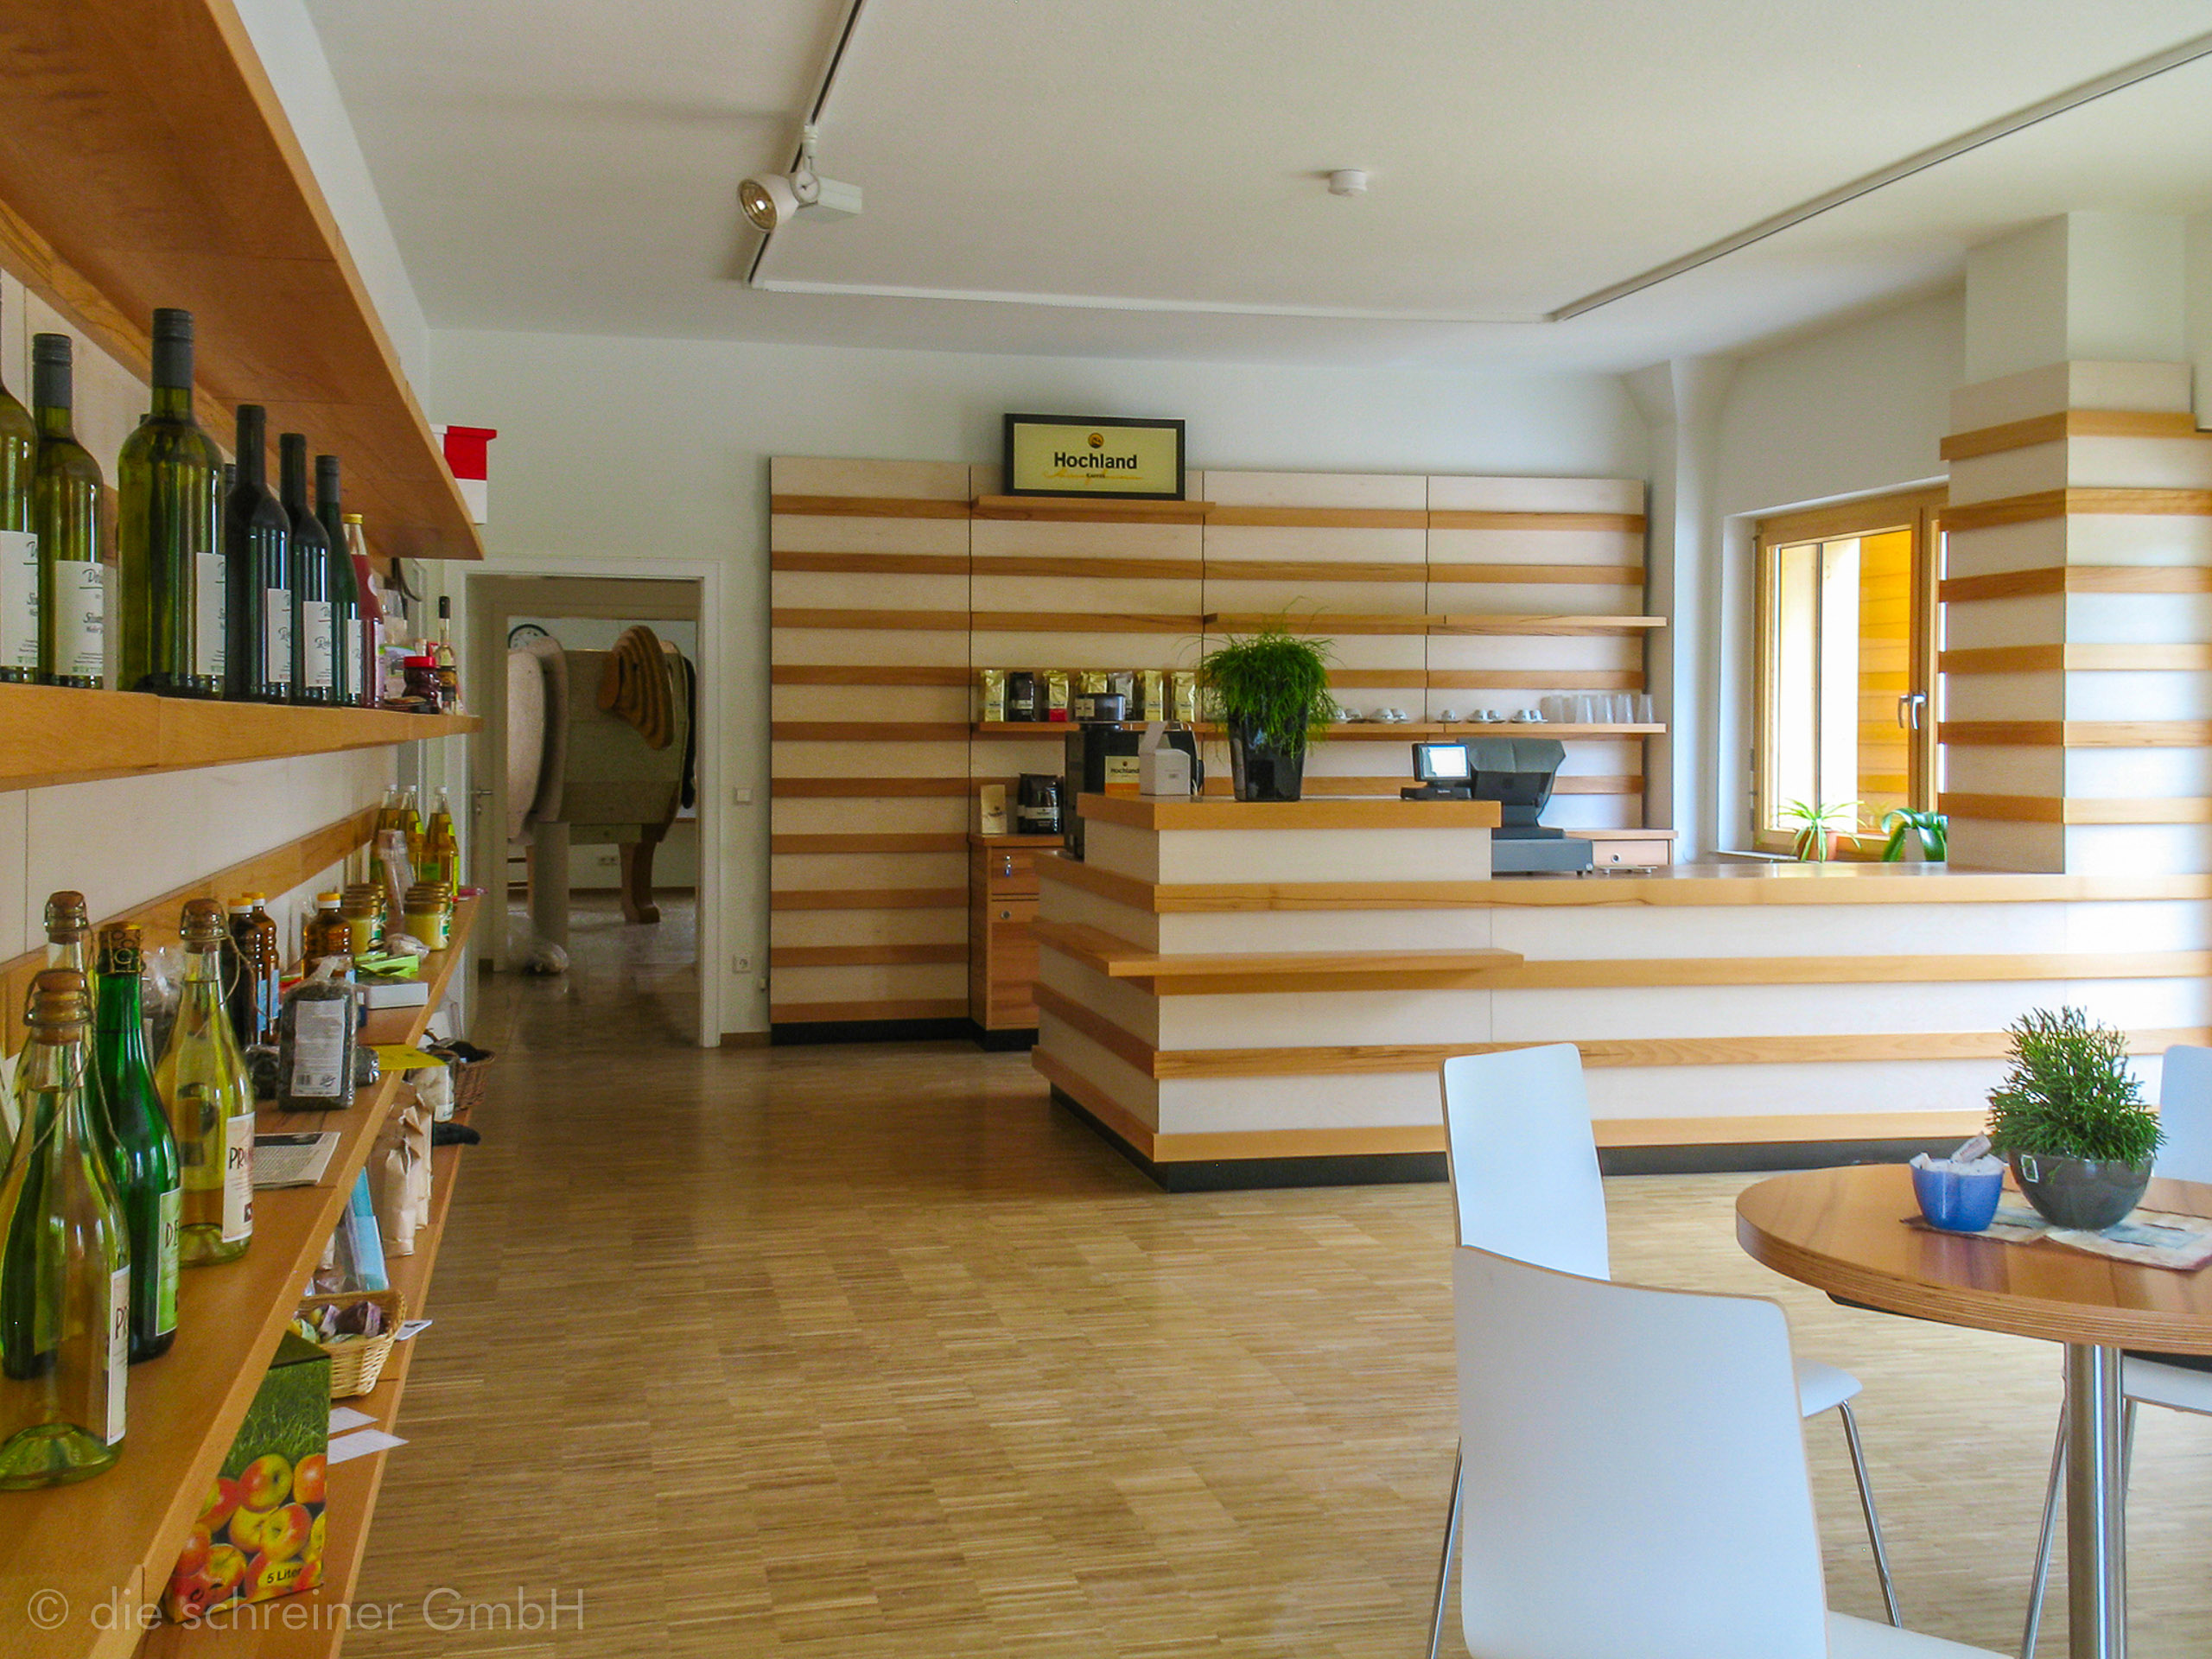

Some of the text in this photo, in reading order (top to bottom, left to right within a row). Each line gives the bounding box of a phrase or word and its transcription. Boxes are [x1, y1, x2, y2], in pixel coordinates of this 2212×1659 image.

[1054, 452, 1138, 469] Hochland
[267, 1567, 302, 1584] 5 Liter
